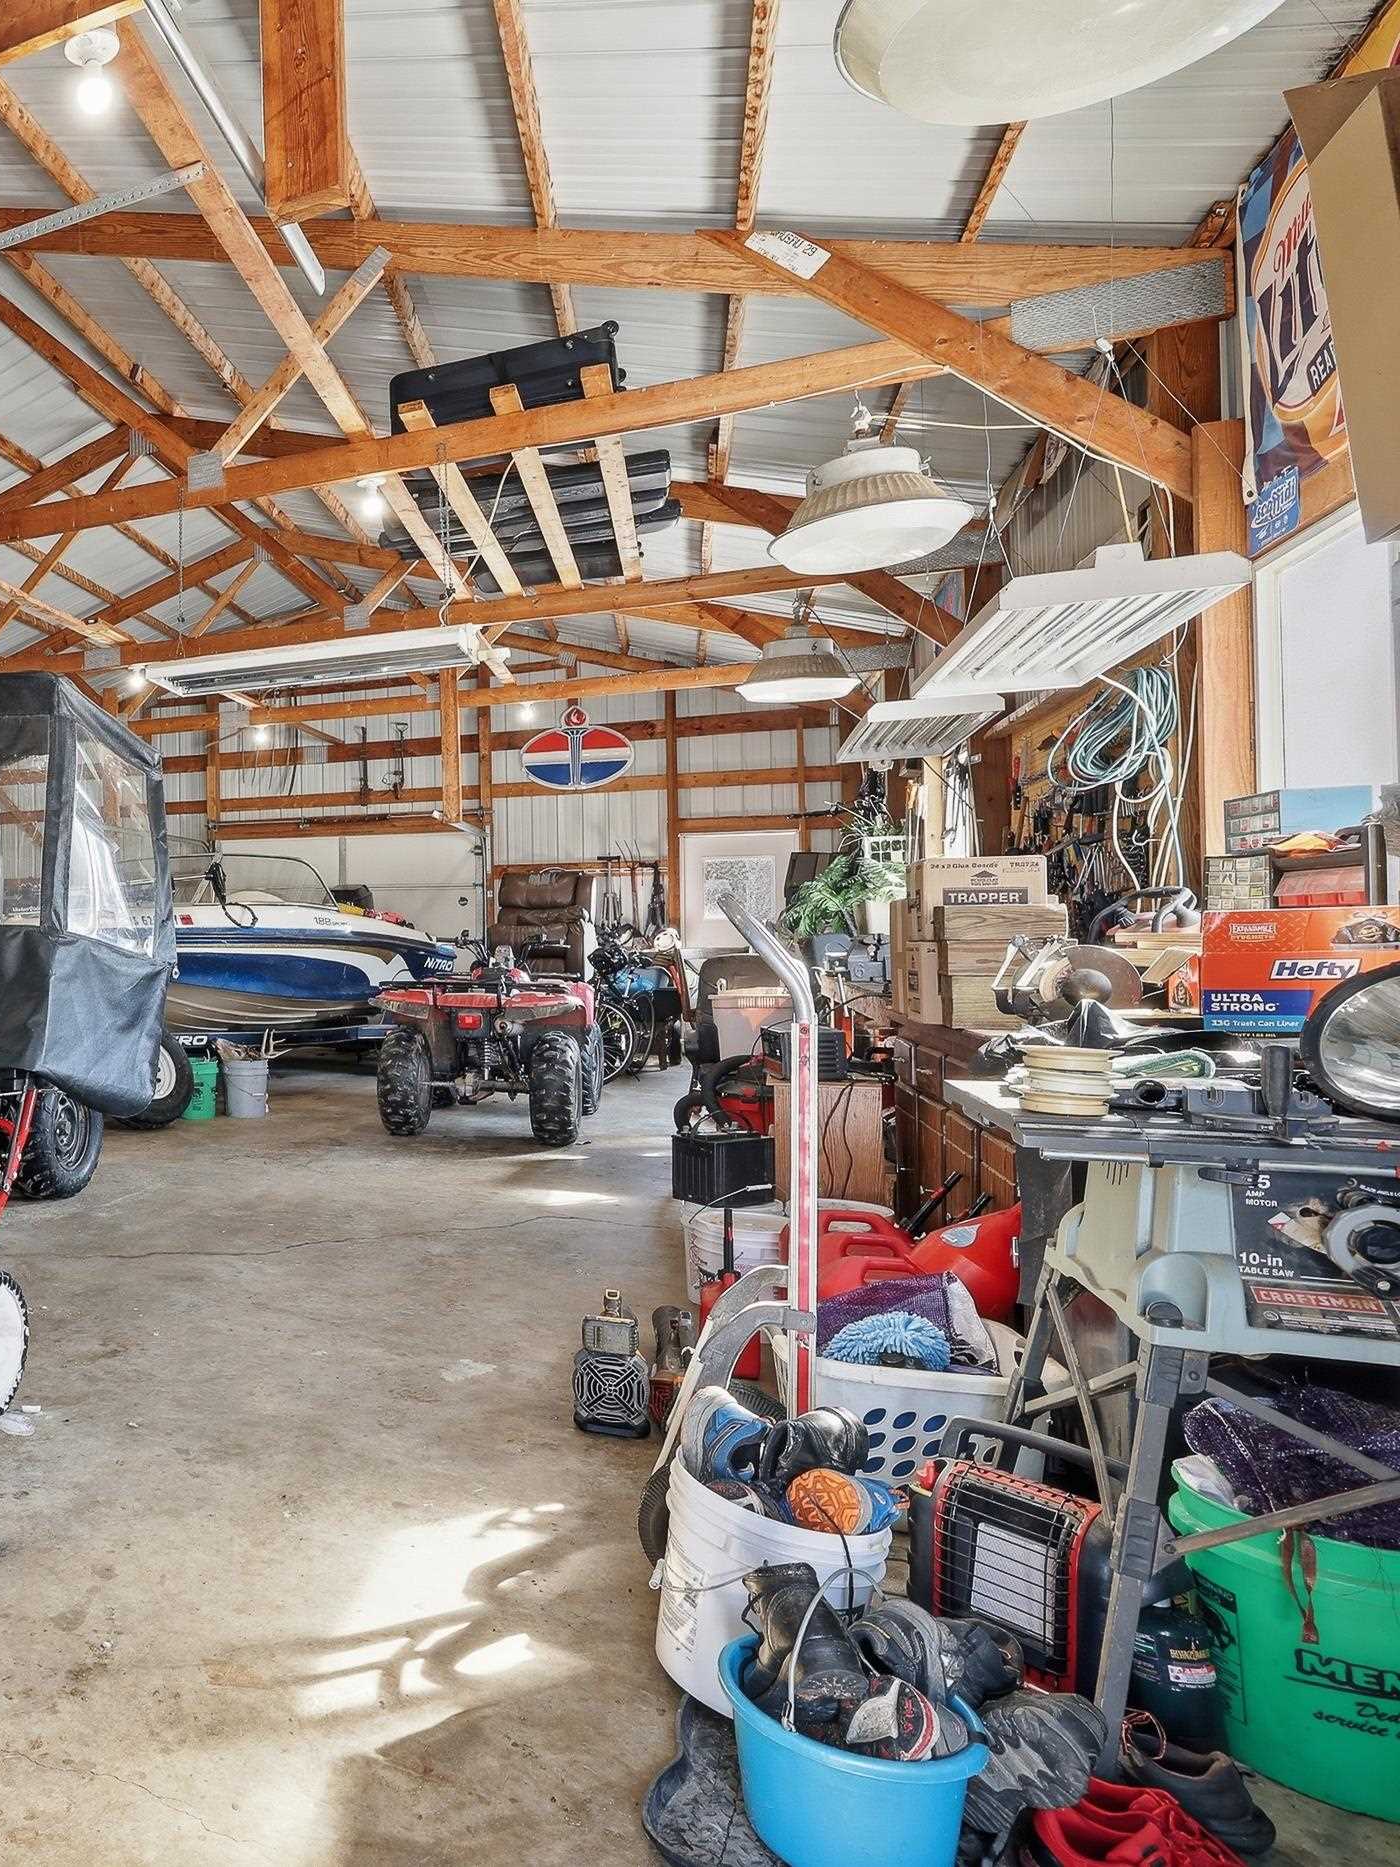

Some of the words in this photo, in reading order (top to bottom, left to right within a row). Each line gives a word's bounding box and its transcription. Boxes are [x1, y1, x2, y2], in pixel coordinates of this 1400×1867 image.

[1273, 191, 1312, 282] Mill
[947, 892, 1020, 904] TRAPPER
[423, 957, 454, 972] NITRO
[1275, 960, 1356, 980] Hefty
[1210, 993, 1264, 1003] ULTRA
[1210, 1002, 1278, 1013] STRONG
[1233, 1019, 1256, 1027] Trash
[1257, 1019, 1274, 1027] Can
[1245, 1190, 1265, 1198] AMP
[1245, 1198, 1278, 1208] MOTOR
[1238, 1252, 1284, 1268] 10-in
[1238, 1265, 1271, 1277] TABLE
[1271, 1268, 1295, 1279] SAW
[1259, 1289, 1378, 1312] CRAFTSMAN
[1312, 1710, 1389, 1737] service
